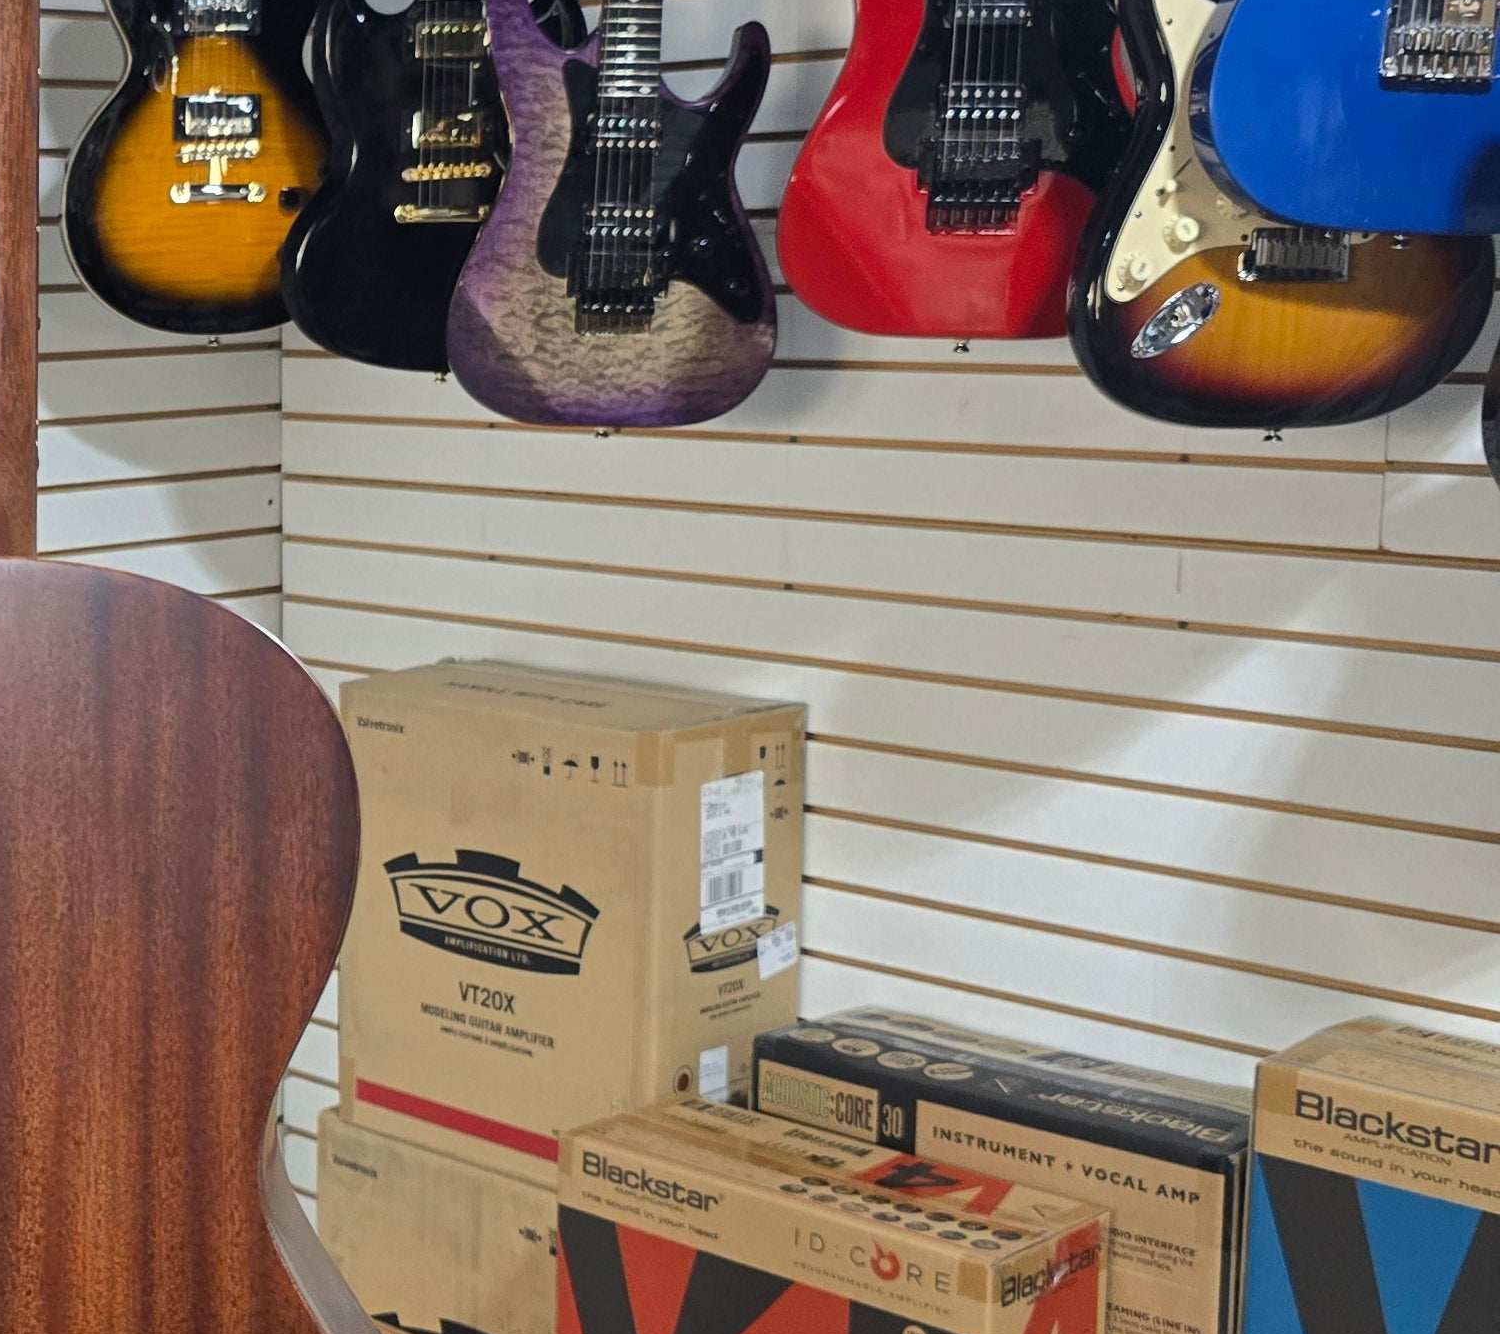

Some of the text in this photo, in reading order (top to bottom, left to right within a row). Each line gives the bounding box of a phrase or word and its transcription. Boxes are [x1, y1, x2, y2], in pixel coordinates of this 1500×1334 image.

[355, 715, 405, 736] Valvetronix
[409, 883, 564, 945] VOX
[444, 934, 509, 961] AMPLIFICATION
[695, 923, 766, 953] VOX
[457, 980, 516, 1016] VT20X
[419, 1002, 467, 1026] MODELING
[468, 1014, 503, 1035] GUITAR
[504, 1025, 556, 1050] AMPLIFIER
[881, 1104, 904, 1139] 30
[1296, 1088, 1500, 1165] Blackstar
[932, 1124, 1057, 1169] INSTRUMENT
[1081, 1163, 1148, 1194] VOCAL
[1155, 1180, 1201, 1207] AMP
[1293, 1138, 1325, 1154] the
[1329, 1147, 1385, 1170] sound
[1388, 1161, 1406, 1175] in
[1411, 1167, 1454, 1187] your
[1343, 1131, 1453, 1168] AMPLIFICATION
[582, 1150, 720, 1213] Blackstar
[1134, 1232, 1197, 1258] INTERFACE
